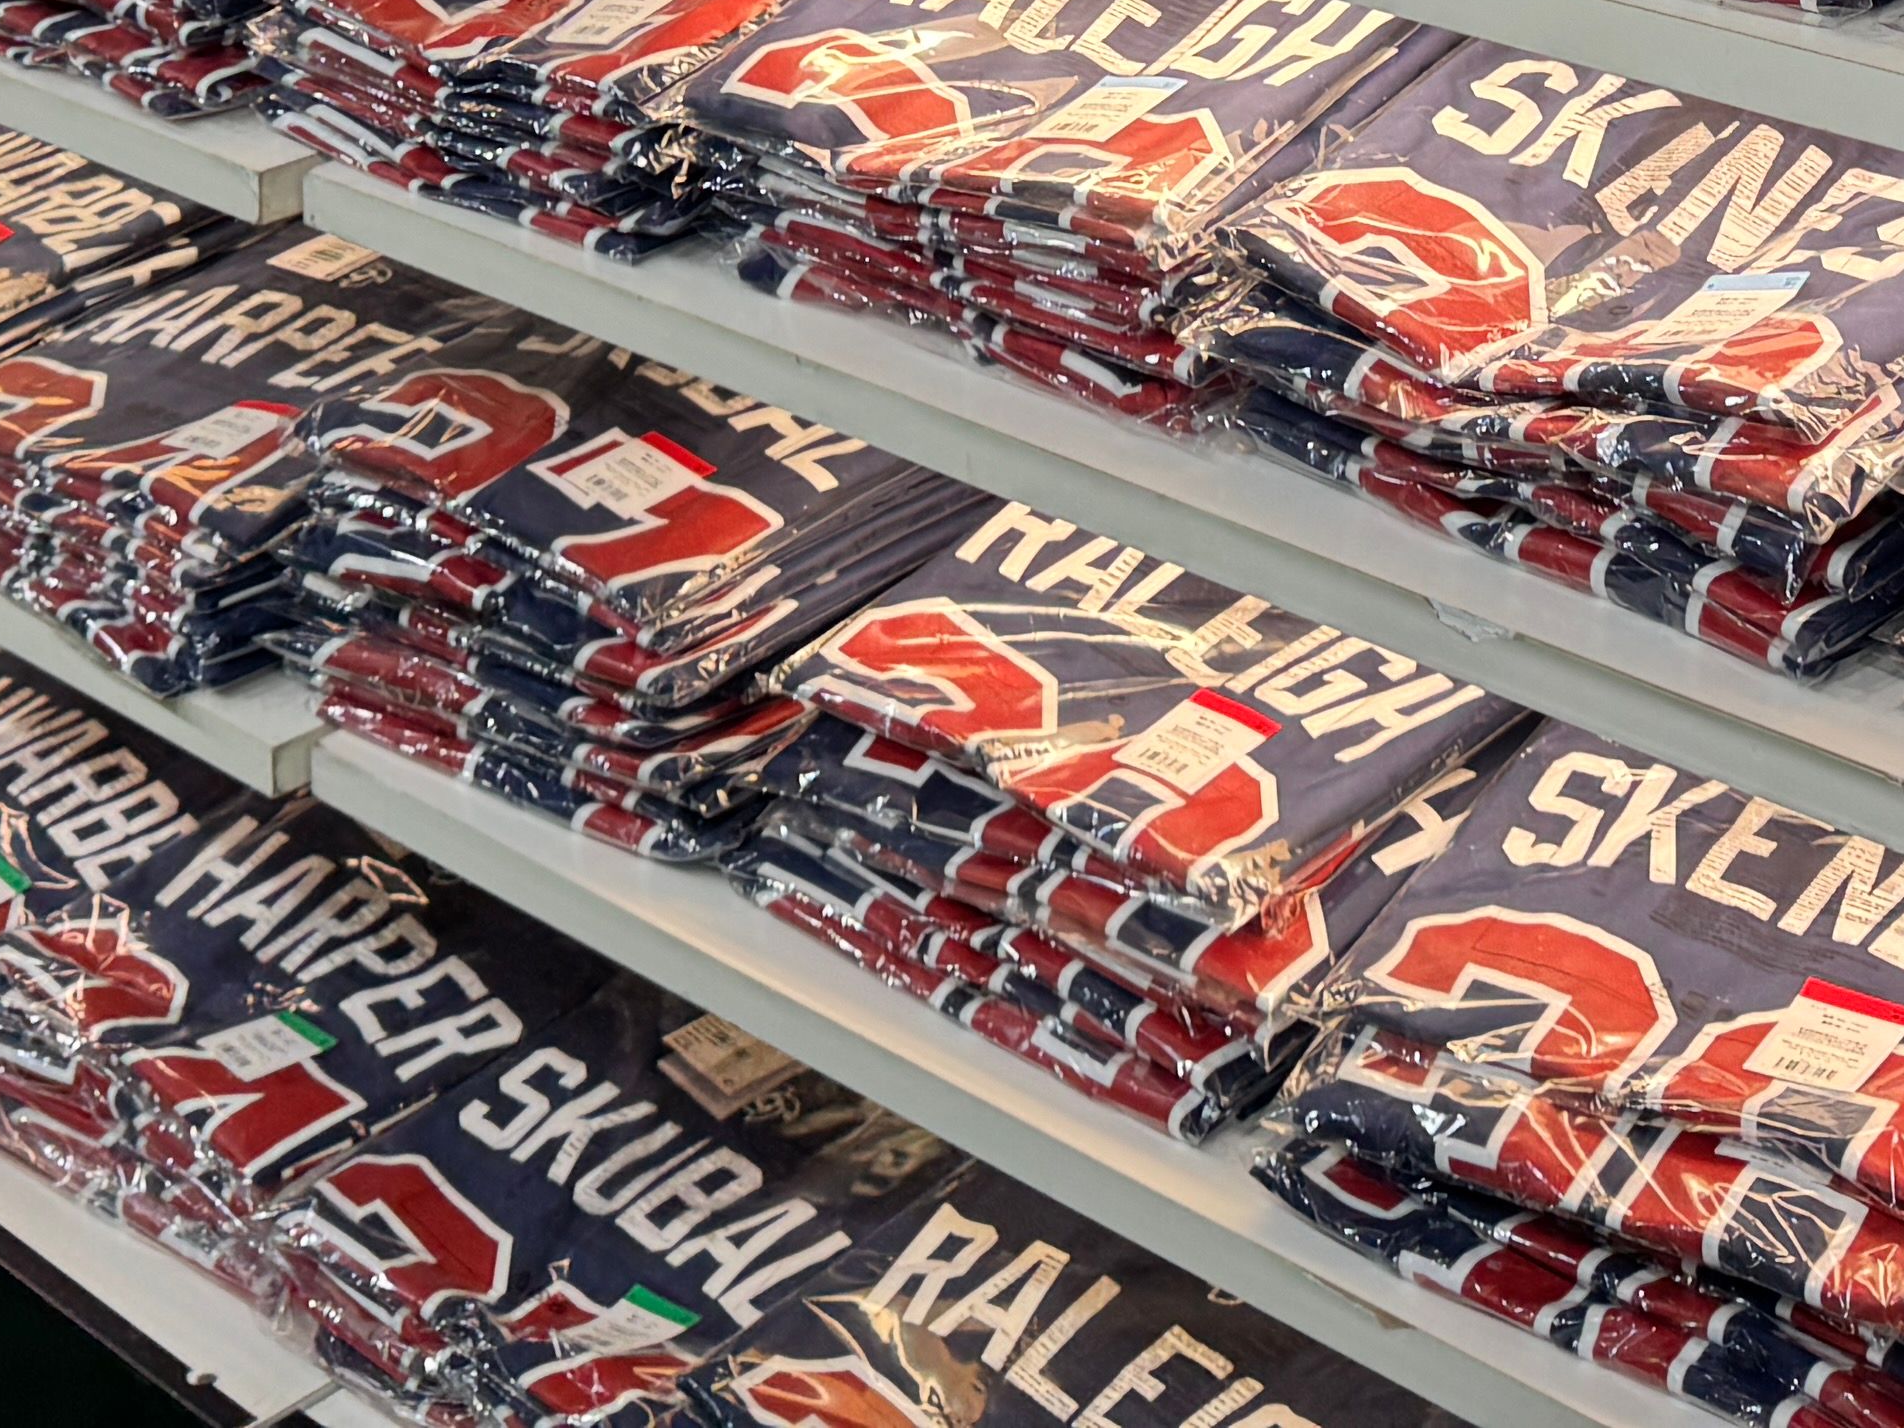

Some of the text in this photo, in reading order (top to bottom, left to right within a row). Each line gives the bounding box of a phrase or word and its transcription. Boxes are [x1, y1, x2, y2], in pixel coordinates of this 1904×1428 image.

[154, 815, 524, 1083] HARPER
[458, 1045, 851, 1326] SKUBAL
[860, 1201, 1323, 1428] RALEI
